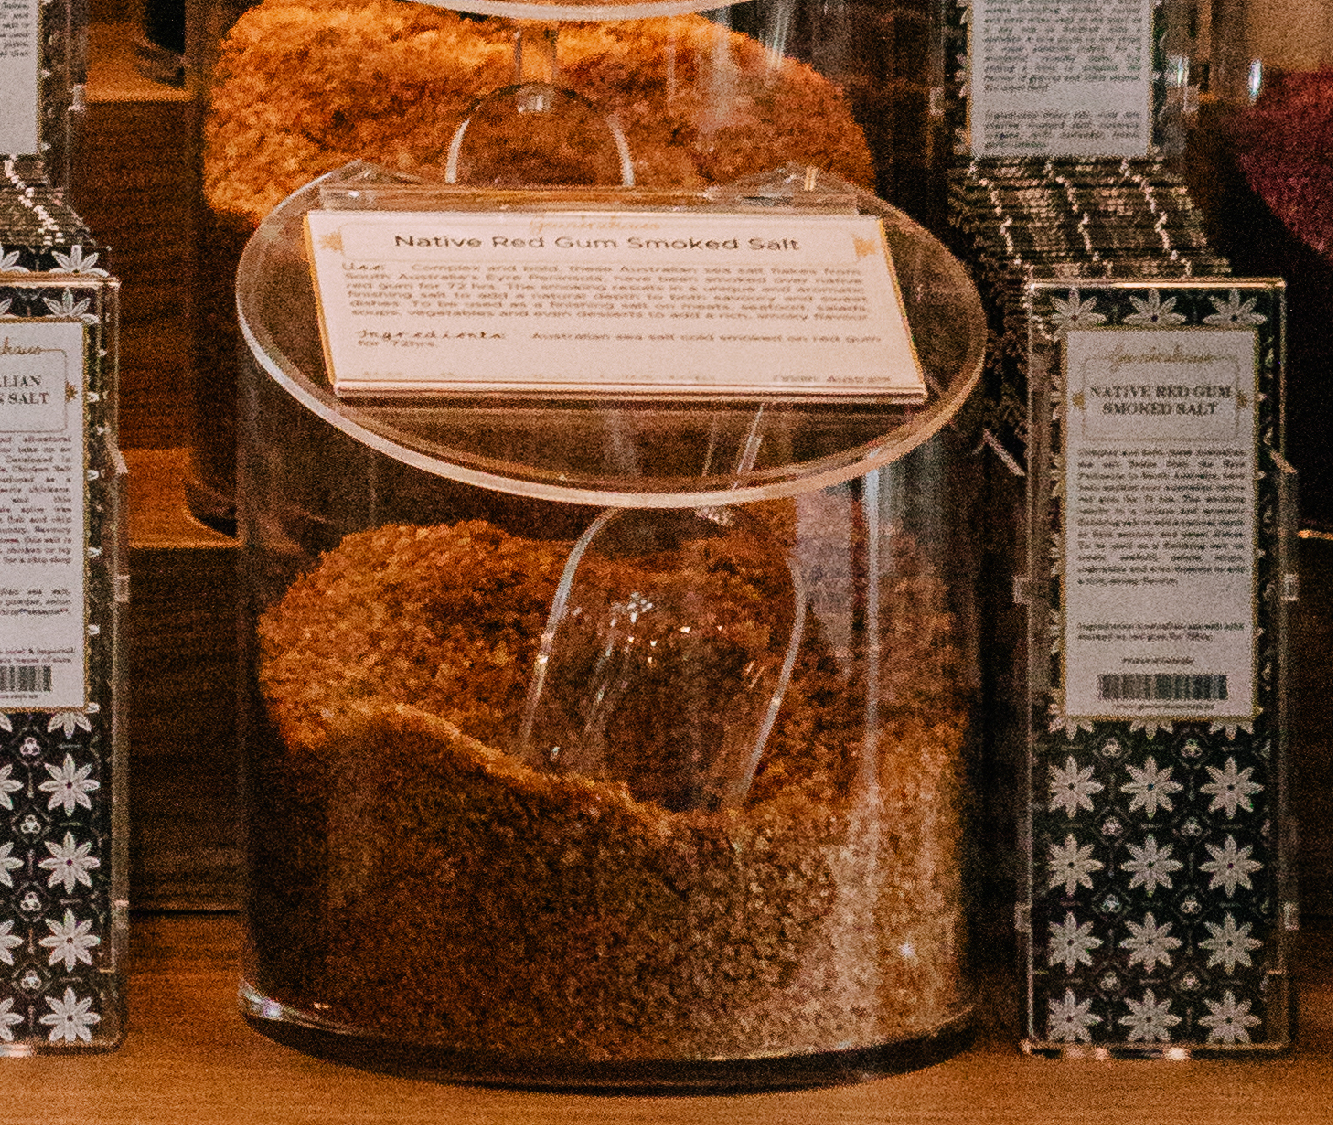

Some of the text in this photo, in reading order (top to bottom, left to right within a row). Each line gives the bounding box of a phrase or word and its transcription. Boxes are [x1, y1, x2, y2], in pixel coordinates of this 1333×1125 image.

[394, 235, 800, 250] Native Red Gum Smoked Salt
[7, 392, 50, 406] SALT
[1089, 385, 1232, 399] NATIVE RED GUM
[1101, 401, 1220, 416] SMOKED SALT
